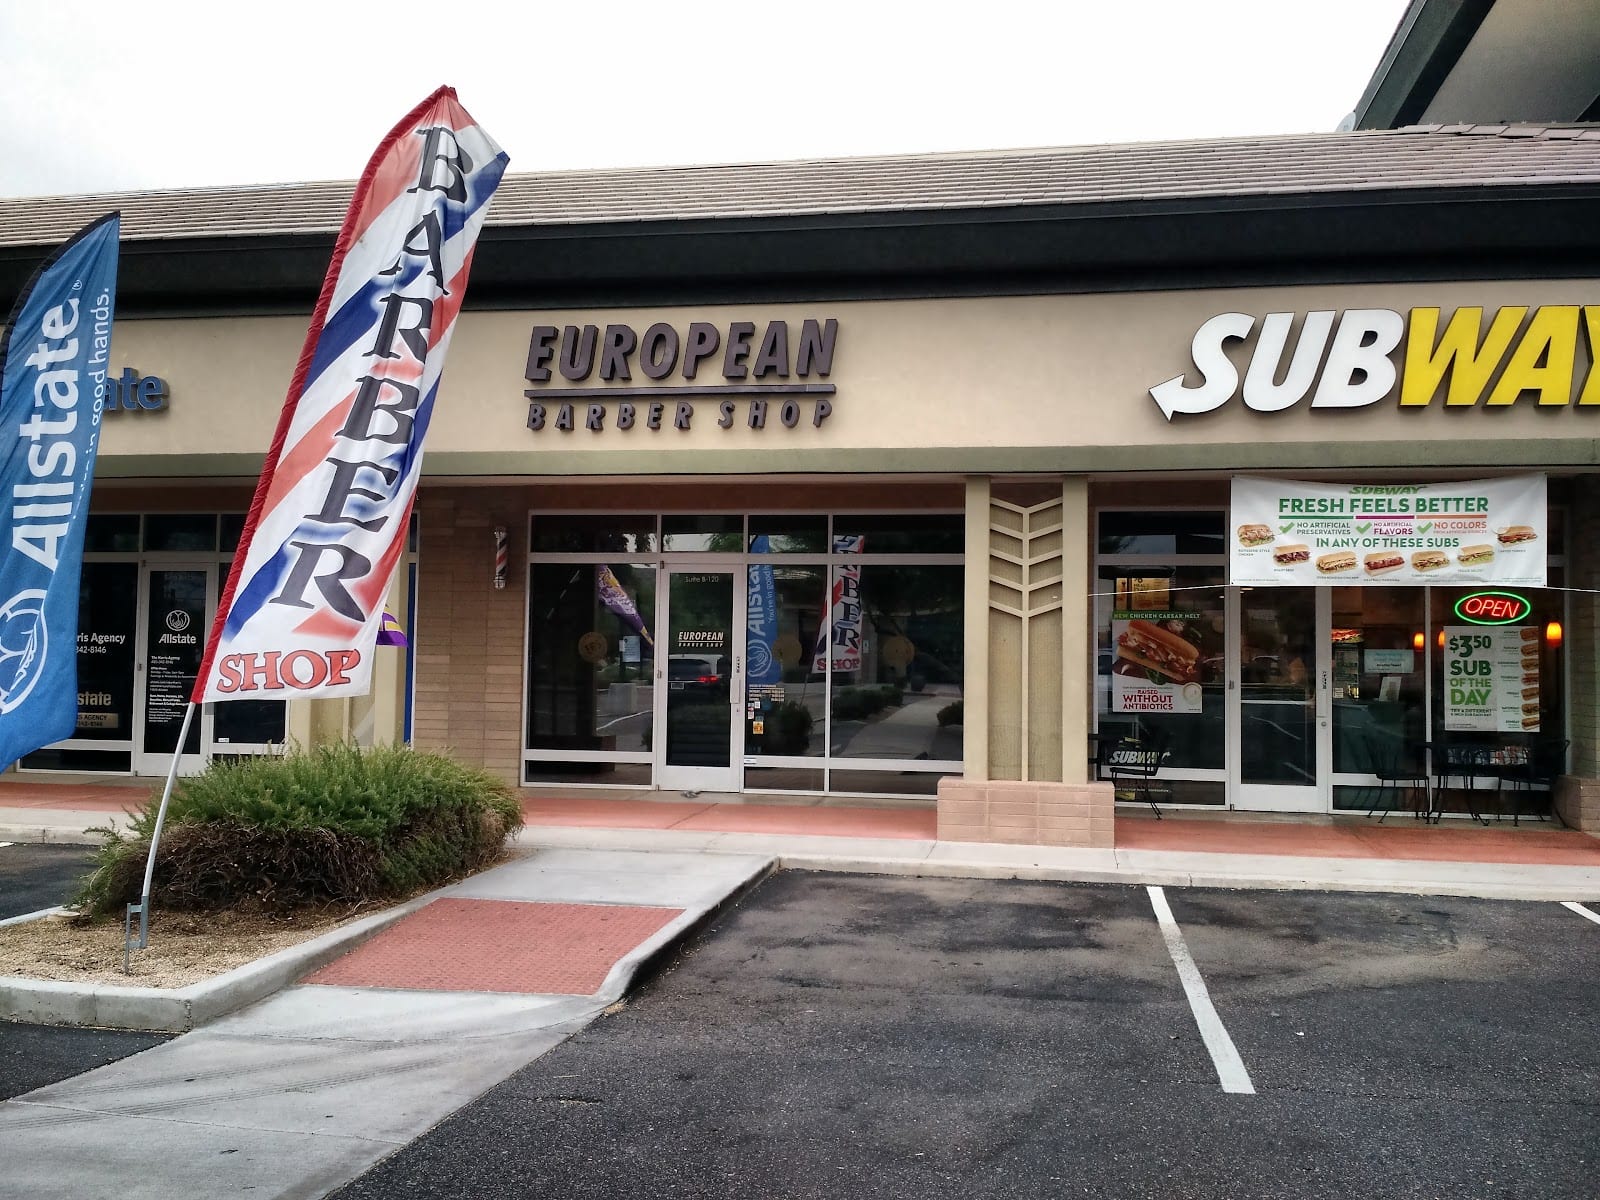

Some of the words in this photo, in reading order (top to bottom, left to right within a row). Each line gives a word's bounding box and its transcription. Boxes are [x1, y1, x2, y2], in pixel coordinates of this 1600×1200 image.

[88, 287, 110, 365] hands.
[524, 318, 838, 381] EUROPEAN
[269, 126, 474, 622] BARBER
[526, 402, 694, 431] BARBER
[717, 400, 833, 429] SHOP
[12, 297, 81, 575] Allstate
[1349, 486, 1422, 495] SUBWAY
[1278, 498, 1344, 513] FRESH
[1349, 498, 1410, 513] FEELS
[1415, 497, 1489, 512] BETTER
[1373, 527, 1414, 535] FLAVORS
[1433, 521, 1448, 529] NO
[1450, 521, 1487, 529] COLORS
[1316, 538, 1329, 547] IN
[1331, 538, 1359, 548] ANY
[1362, 538, 1379, 548] OF
[1382, 538, 1423, 548] THESE
[1426, 538, 1460, 548] SUBS
[1465, 598, 1520, 618] OPEN
[91, 633, 126, 645] Agency
[158, 633, 197, 644] Allstate
[678, 631, 724, 641] EUROPEAN
[216, 648, 361, 692] SHOP
[1450, 660, 1492, 676] SUB
[1450, 678, 1467, 688] OF
[1468, 678, 1492, 688] THE
[1122, 694, 1173, 703] WITHOUT
[1450, 689, 1492, 705] DAY
